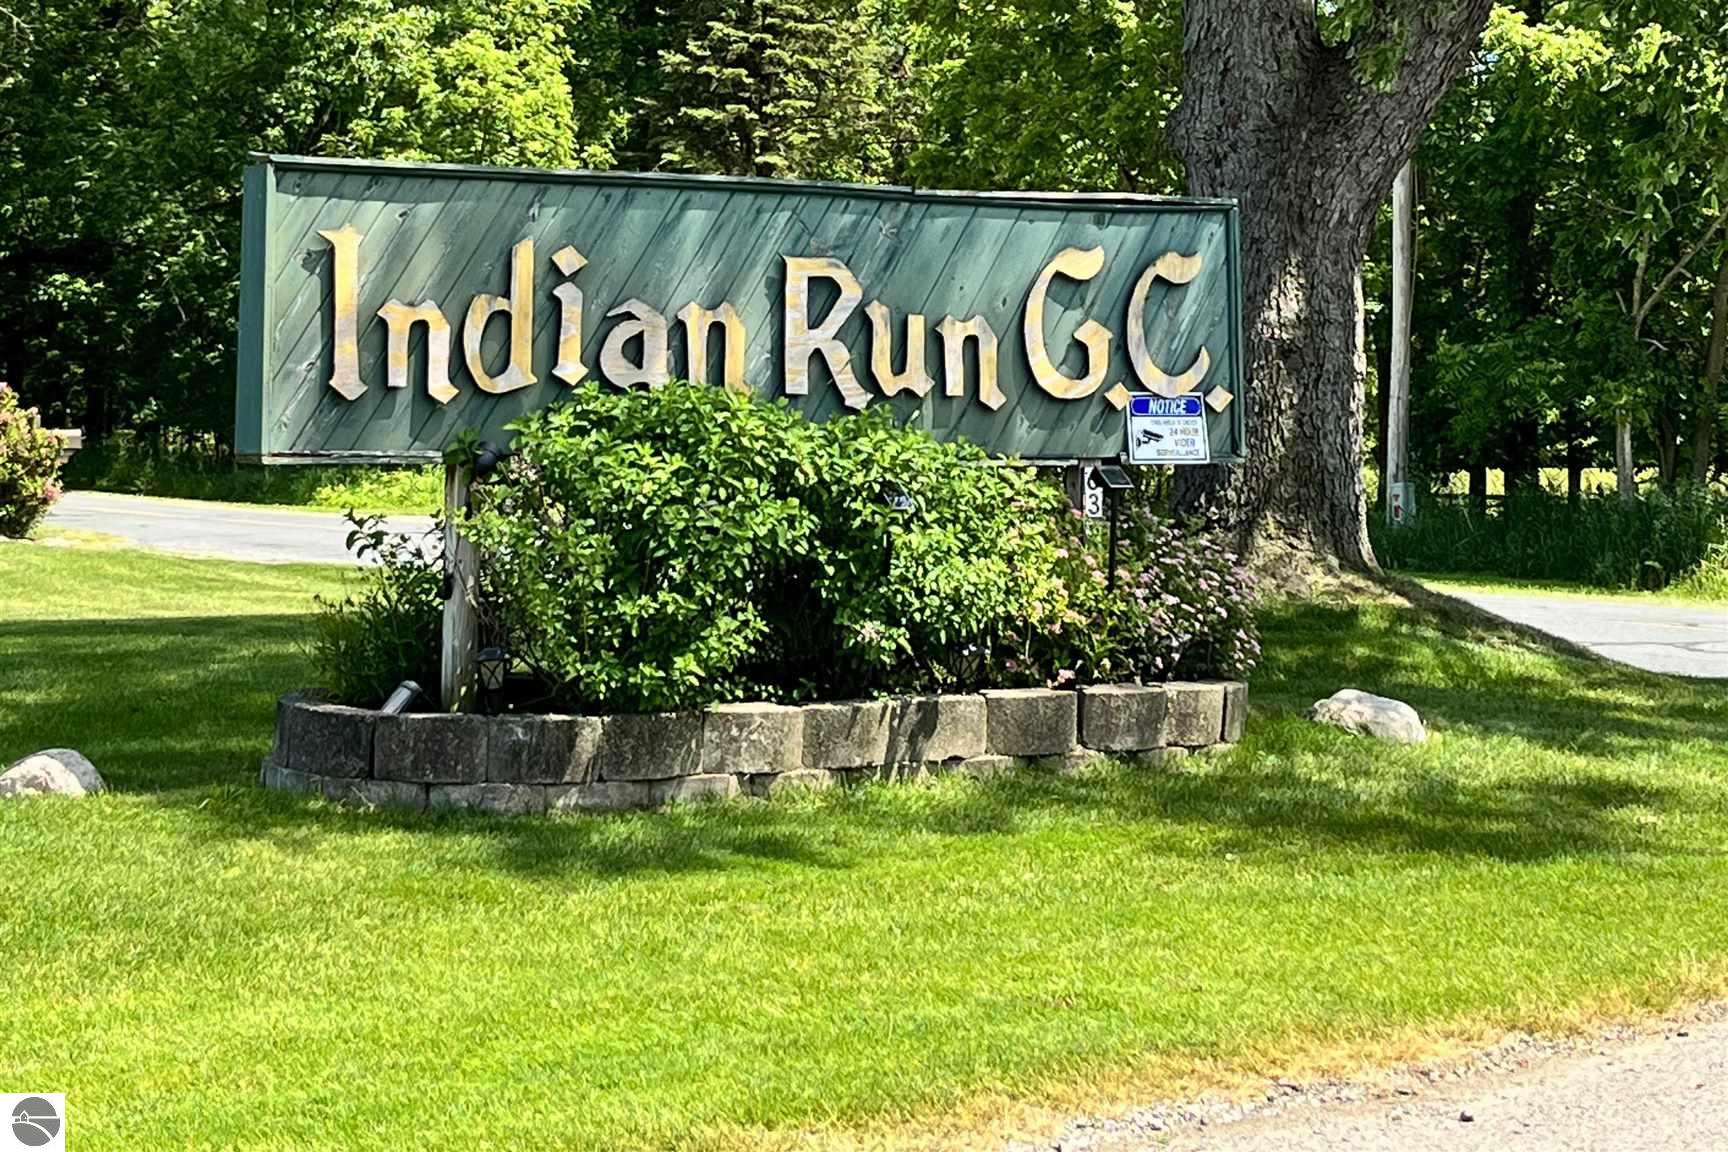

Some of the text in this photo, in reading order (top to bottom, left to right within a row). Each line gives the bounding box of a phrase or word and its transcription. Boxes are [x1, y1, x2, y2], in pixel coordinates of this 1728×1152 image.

[316, 223, 754, 406] Indian
[779, 252, 1008, 411] Run
[1148, 397, 1188, 415] NOTICE
